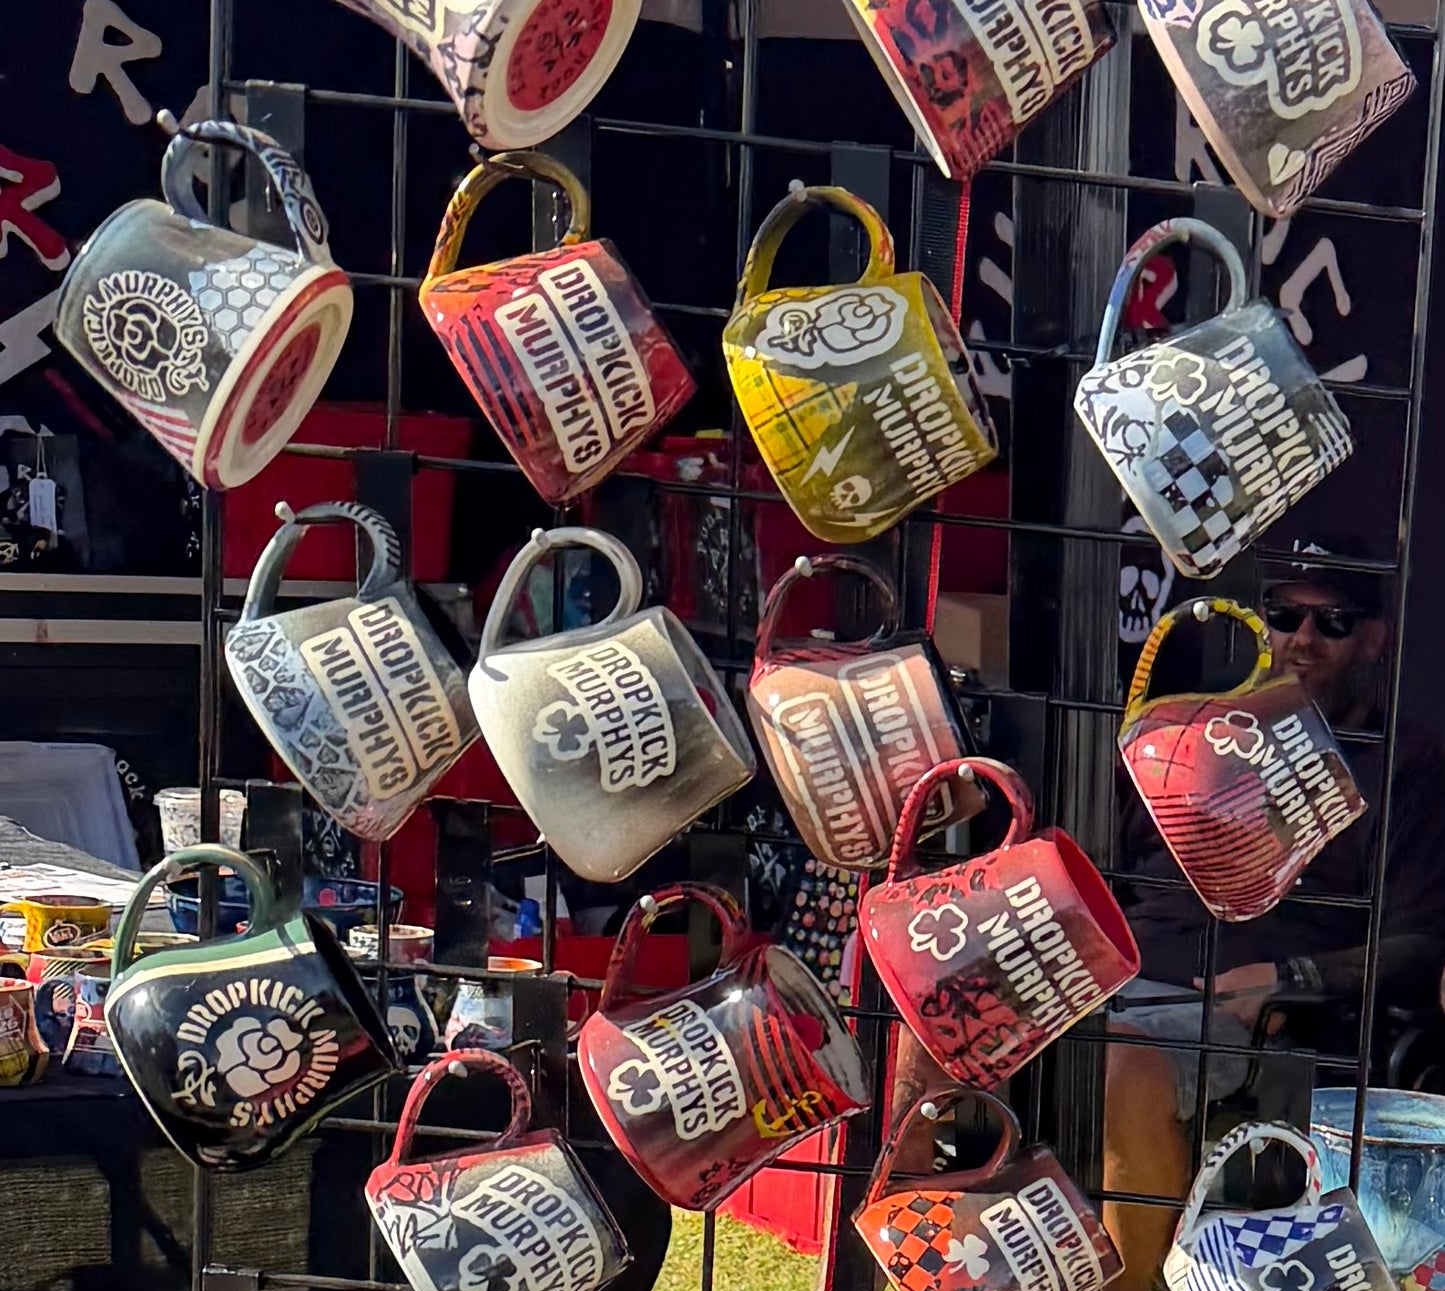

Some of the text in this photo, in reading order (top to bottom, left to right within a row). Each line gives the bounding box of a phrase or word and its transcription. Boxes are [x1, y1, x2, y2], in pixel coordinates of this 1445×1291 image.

[1302, 0, 1346, 90] KICK
[505, 302, 602, 464] MURPHYS
[550, 266, 648, 429] DROPKICK
[863, 383, 947, 494] MURPHY
[890, 352, 977, 481] DROPKIC
[311, 636, 409, 791] MURPHYS
[359, 604, 453, 761] DROPKICK
[558, 661, 635, 786] MURPHYS
[587, 647, 668, 780] DROPKICK
[788, 707, 875, 860] MURPHYS
[1250, 744, 1323, 849] MURPH
[1272, 713, 1351, 828] DROPKIC
[176, 979, 325, 1044] DROPKICK
[660, 1004, 740, 1124] DROPKICK
[230, 1029, 340, 1127] MURPHYS
[631, 1020, 708, 1133] MURPHYS
